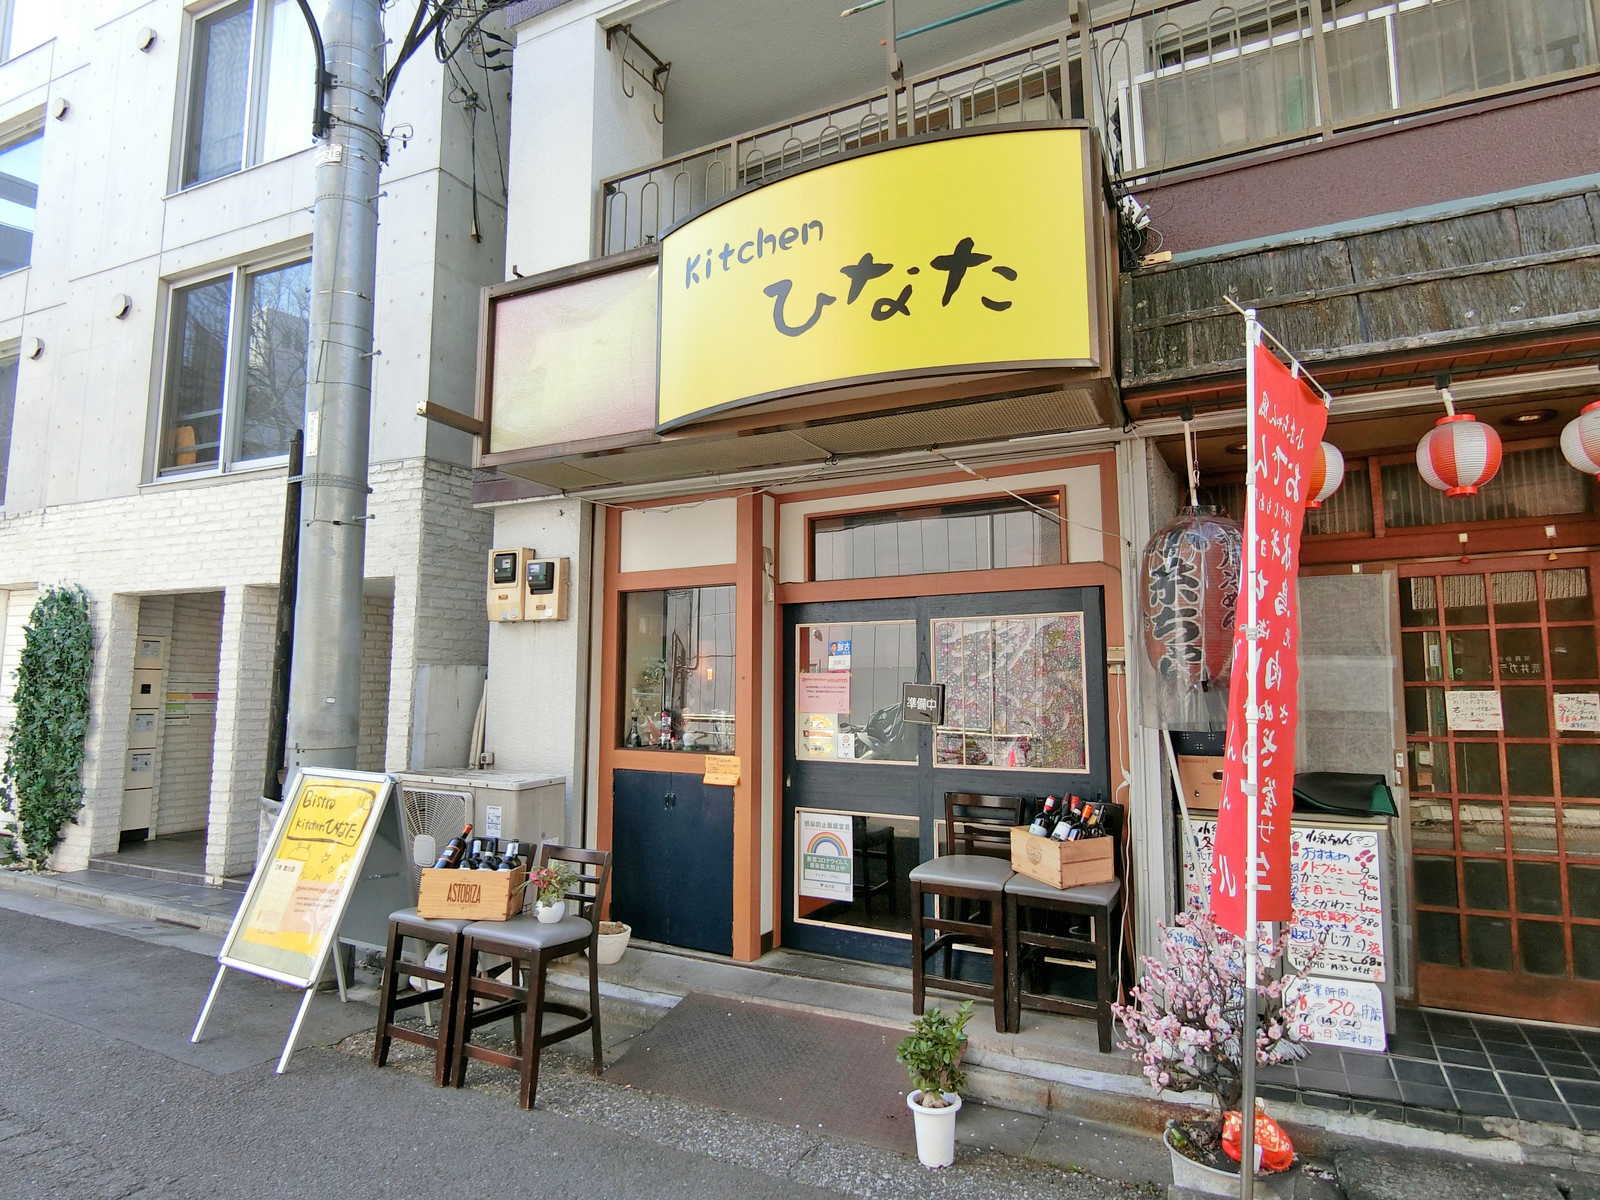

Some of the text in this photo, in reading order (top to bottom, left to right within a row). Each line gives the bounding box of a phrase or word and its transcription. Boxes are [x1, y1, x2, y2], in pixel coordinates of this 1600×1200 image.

[685, 219, 823, 289] Kitchen
[764, 236, 1018, 337] ひなた
[907, 697, 937, 711] 準備中
[302, 790, 336, 809] Bistro
[1302, 847, 1350, 863] おすすめ
[447, 883, 481, 903] ASTOBIZA
